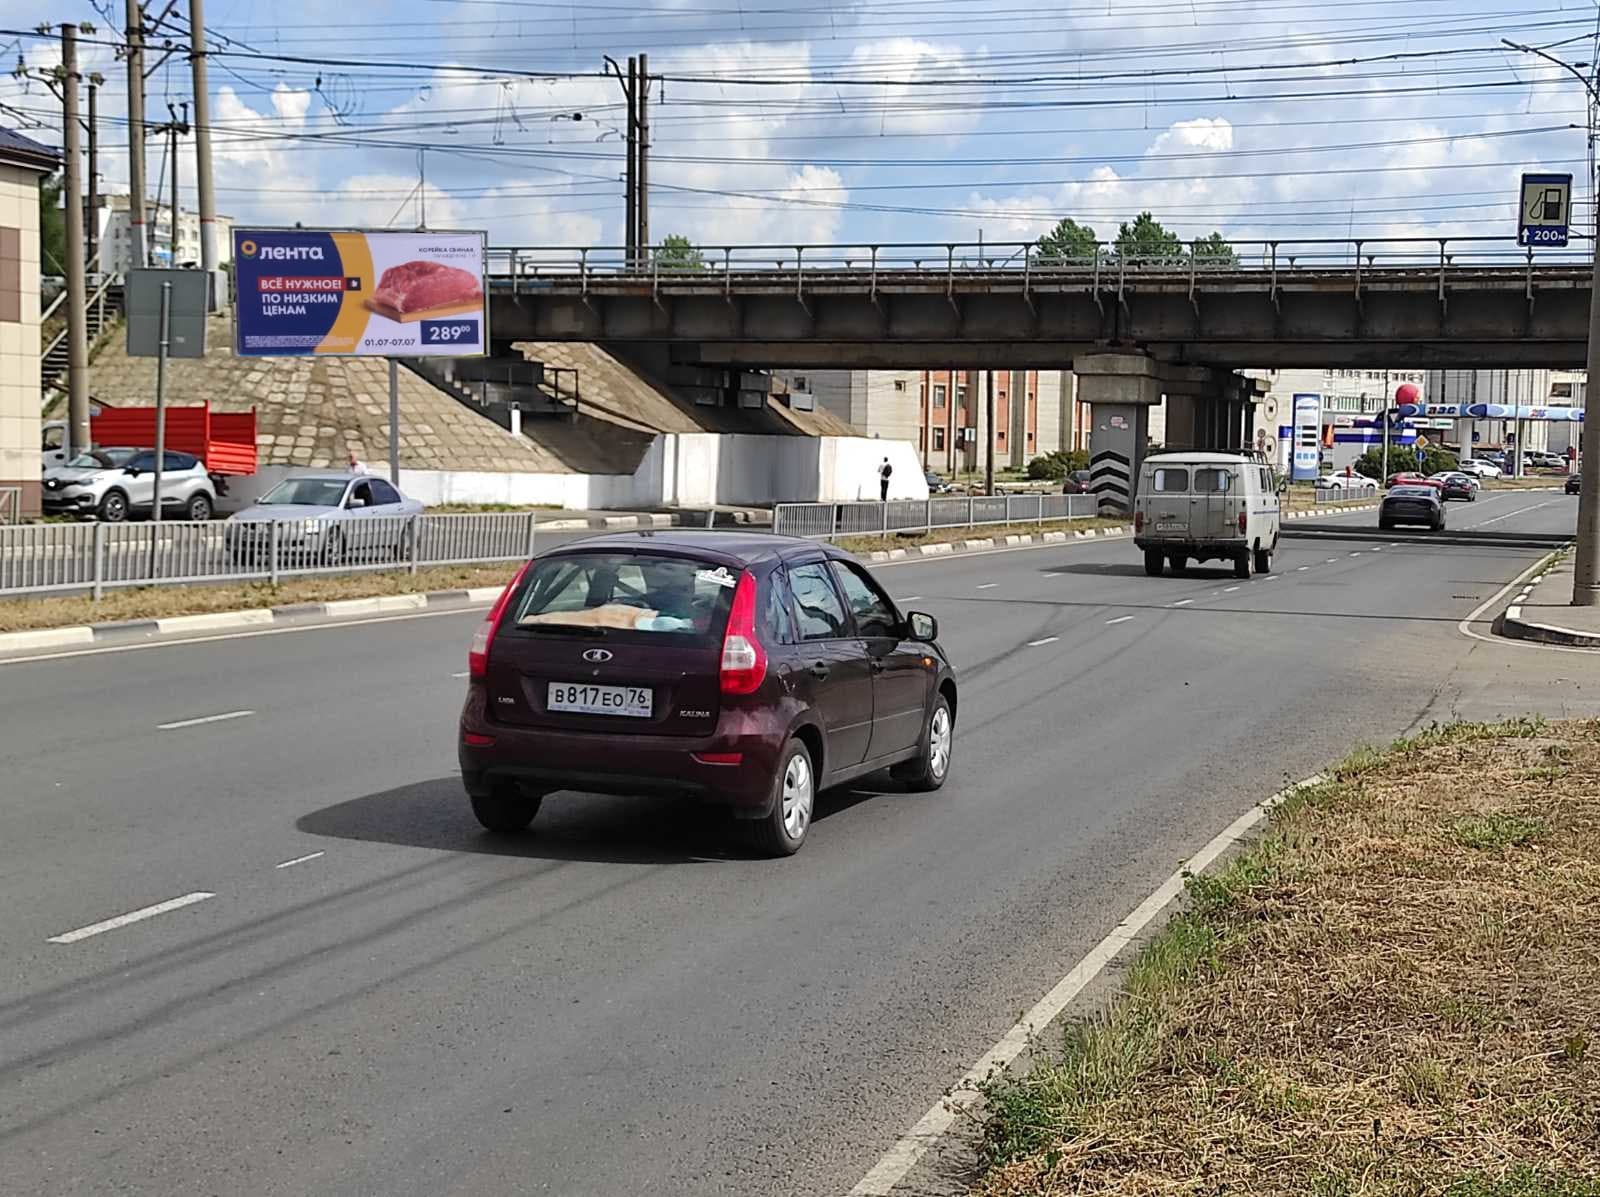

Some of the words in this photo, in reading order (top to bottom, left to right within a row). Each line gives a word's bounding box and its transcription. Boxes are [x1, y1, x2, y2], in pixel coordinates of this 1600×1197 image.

[259, 246, 325, 260] лента
[261, 277, 283, 289] ВСЁ
[285, 279, 342, 289] НУЖНОЕ!
[262, 293, 281, 304] ПО
[284, 293, 338, 304] НИЗКИМ
[262, 305, 307, 316] ЦЕНАМ
[364, 338, 416, 346] 01.07-07.07
[628, 688, 647, 704] 76
